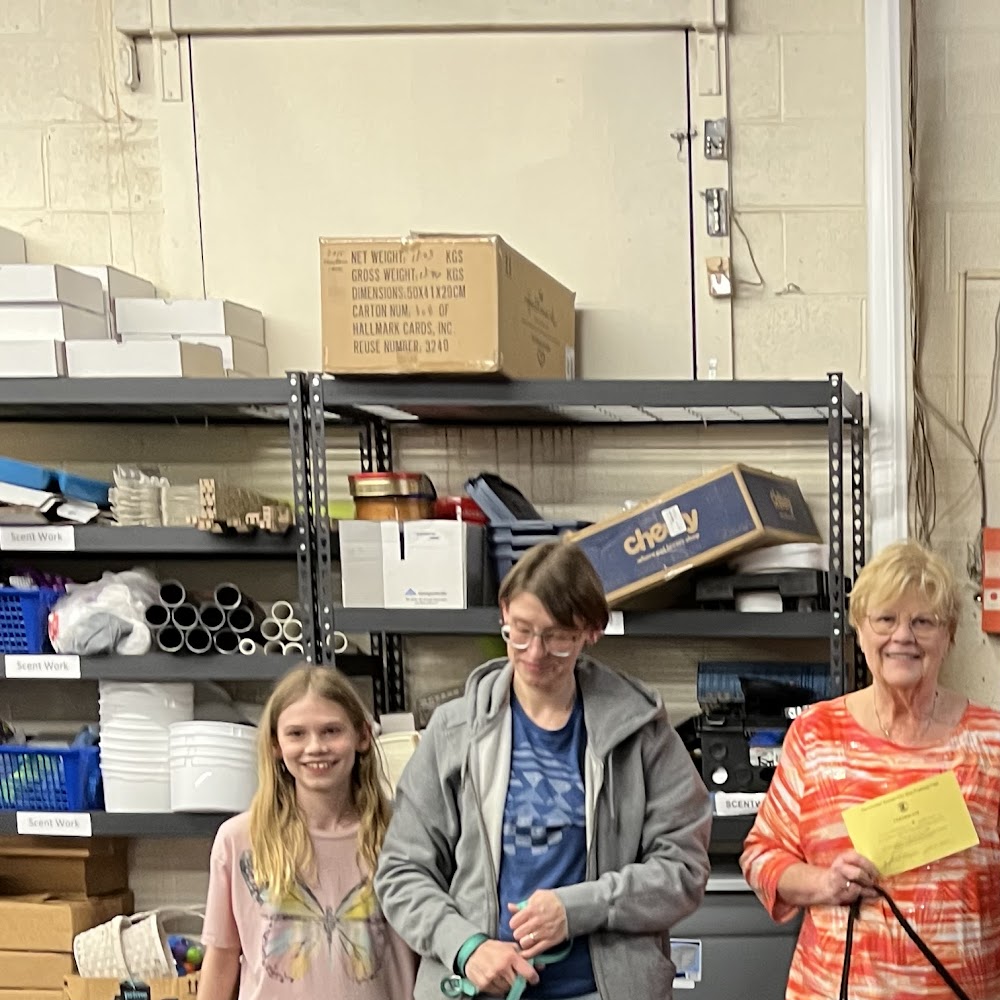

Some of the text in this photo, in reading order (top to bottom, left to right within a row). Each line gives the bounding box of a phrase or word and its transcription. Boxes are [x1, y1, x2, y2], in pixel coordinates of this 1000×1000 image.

[351, 250, 368, 264] NET
[446, 249, 463, 264] KGS
[351, 268, 380, 281] GROSS
[446, 267, 464, 281] KGS
[352, 303, 387, 318] CARTON
[439, 303, 449, 317] OF
[352, 322, 400, 336] HALLMARK
[353, 340, 381, 354] REUSE
[425, 339, 449, 353] 3240
[11, 531, 63, 542] Scent Work
[623, 508, 699, 556] chey
[17, 660, 70, 671] Scent Work
[28, 817, 80, 829] Scent Work
